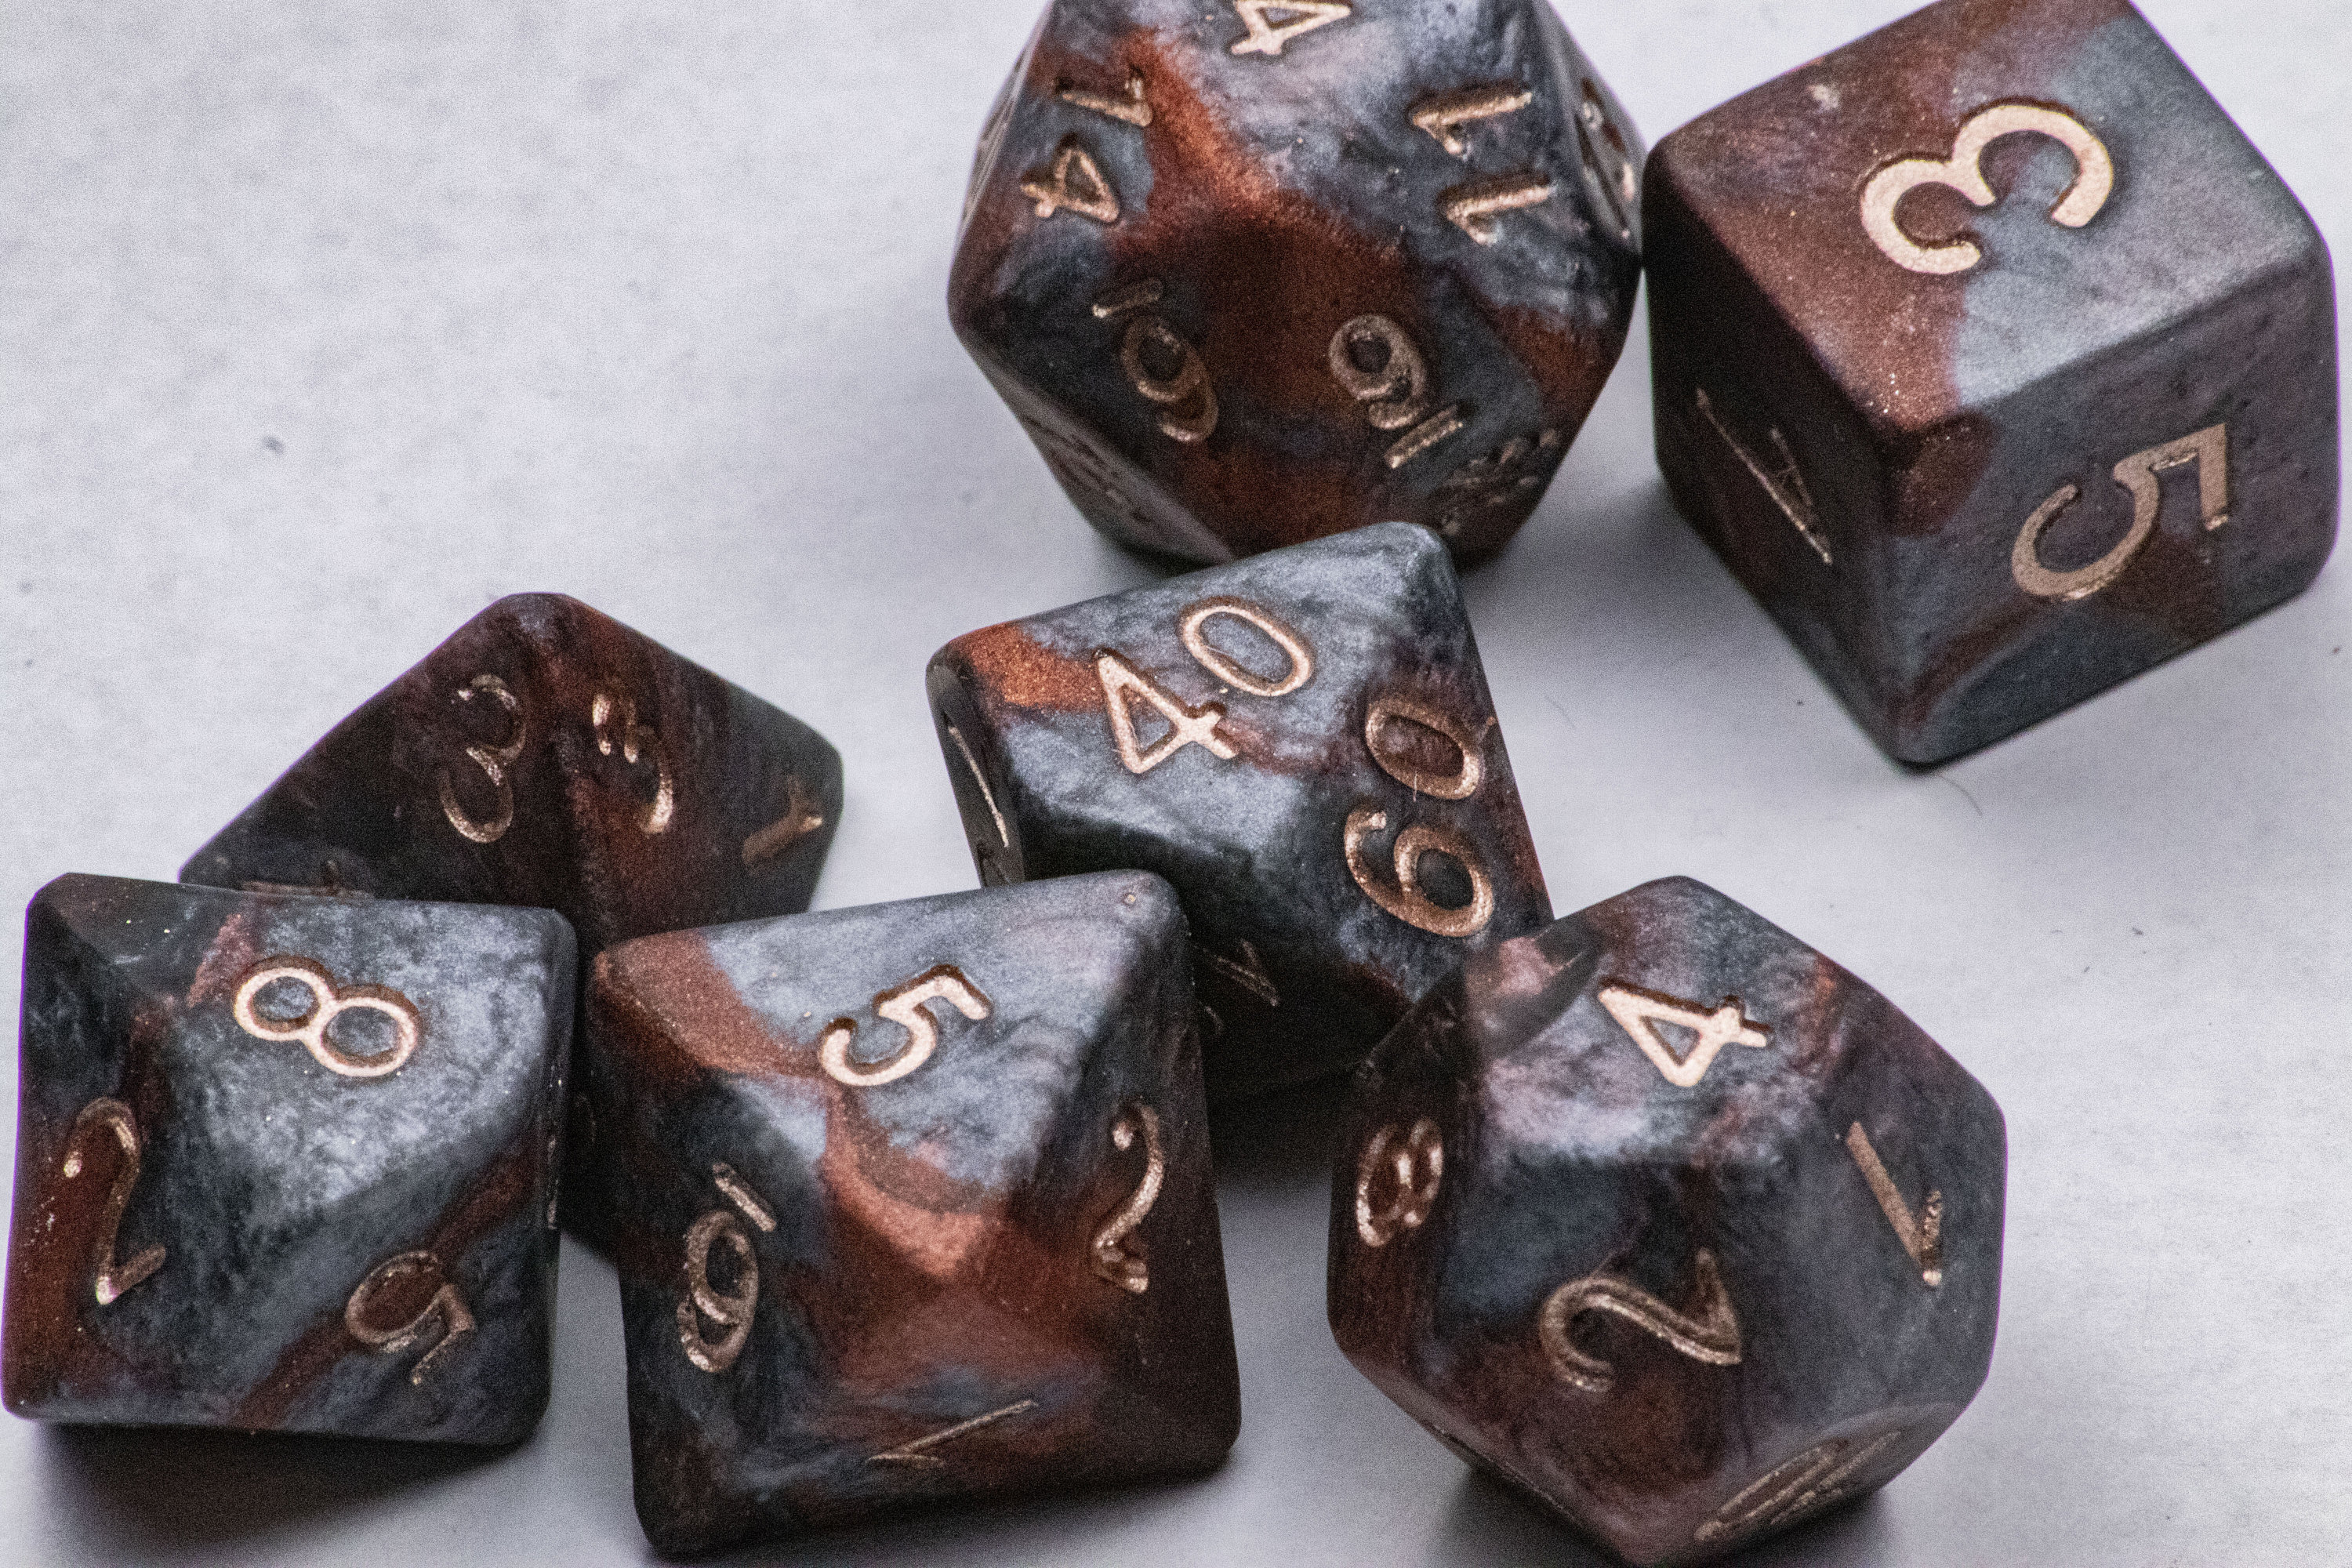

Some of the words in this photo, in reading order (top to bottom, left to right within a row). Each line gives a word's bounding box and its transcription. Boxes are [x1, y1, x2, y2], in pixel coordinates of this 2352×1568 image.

[1231, 0, 1352, 56] 4
[1860, 100, 2114, 275] 3
[2012, 423, 2230, 602] 5
[439, 673, 526, 844] 3
[1096, 601, 1316, 775] 40
[1343, 696, 1495, 938] 60
[234, 964, 420, 1078] 8
[819, 971, 991, 1087] 5
[1598, 983, 1769, 1087] 4
[64, 1097, 167, 1306] 2
[1096, 1102, 1164, 1295] 2
[1846, 1120, 1944, 1287] 1
[1540, 1250, 1744, 1394] 2
